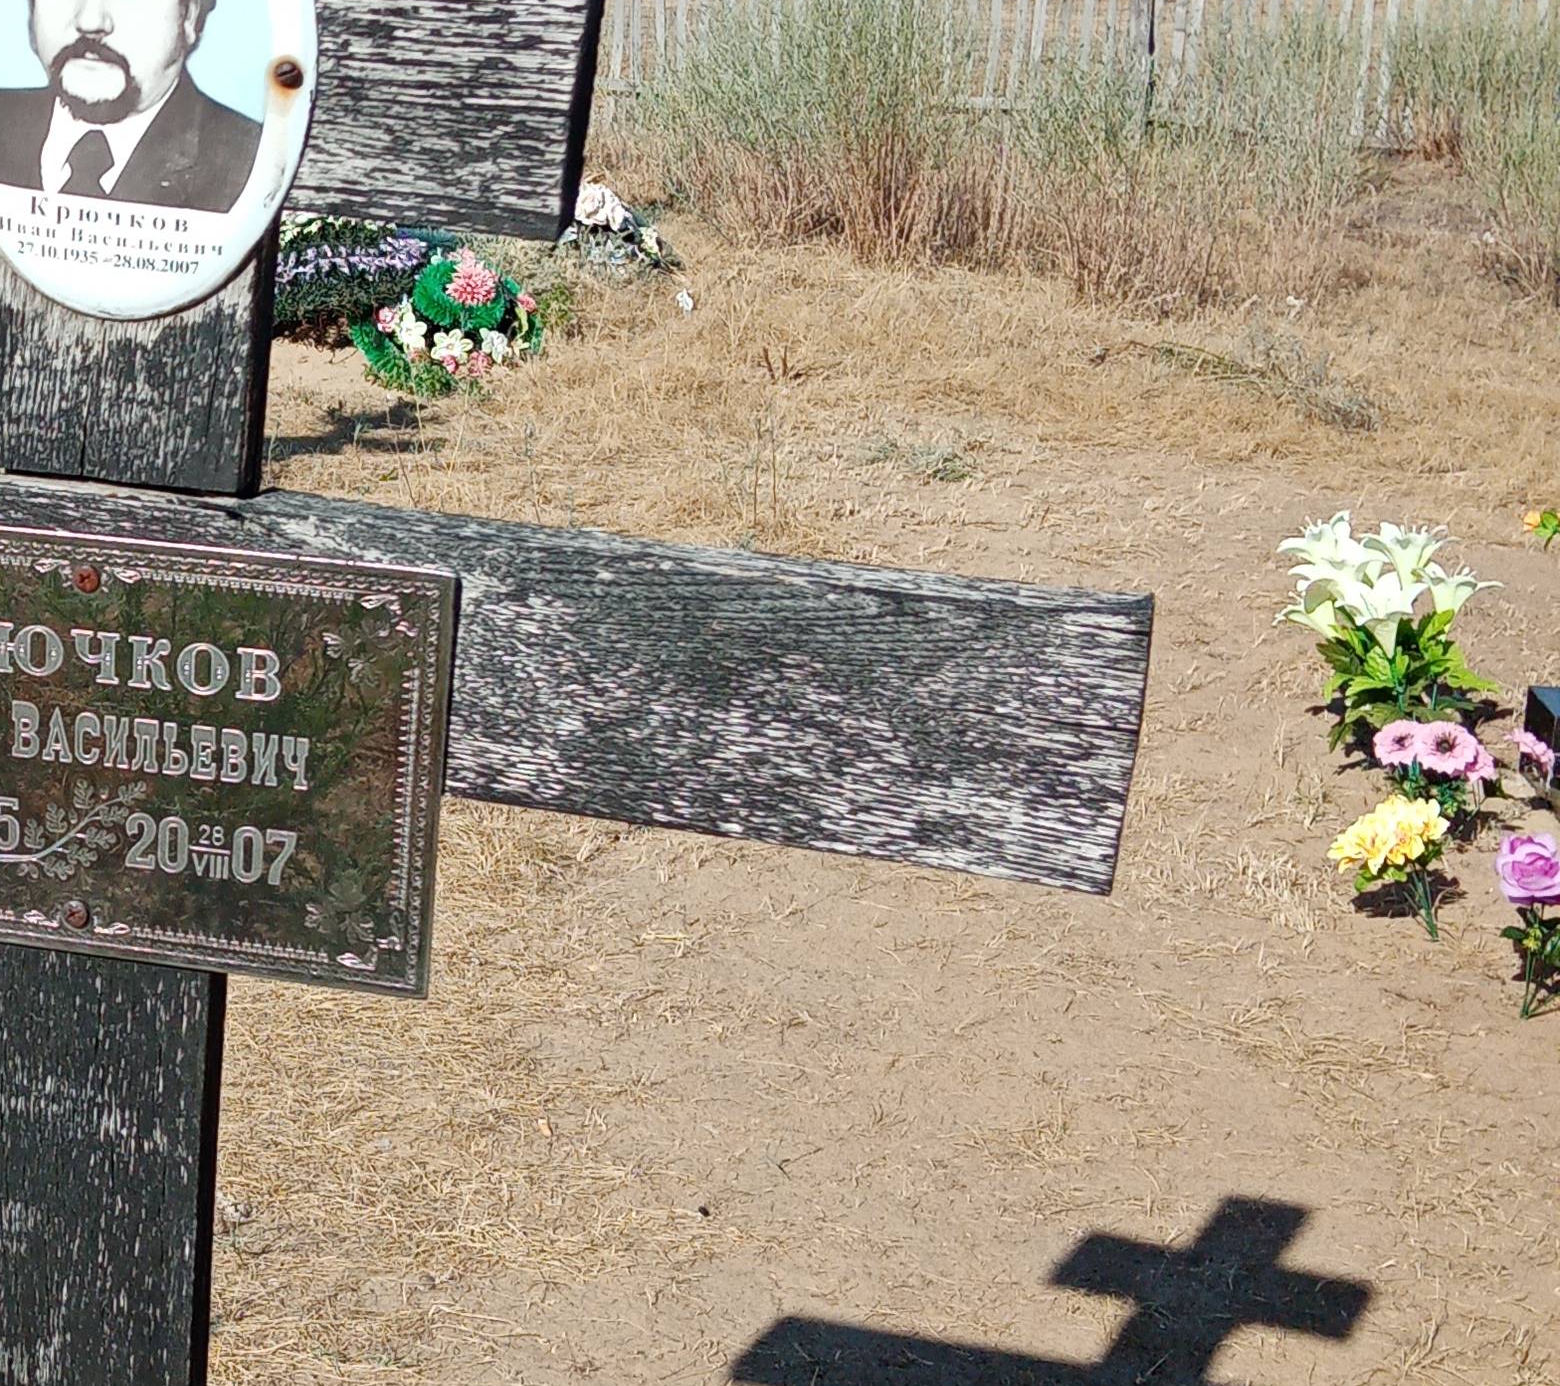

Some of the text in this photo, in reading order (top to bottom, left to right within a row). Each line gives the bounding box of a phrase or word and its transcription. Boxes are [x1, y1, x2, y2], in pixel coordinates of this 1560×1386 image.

[0, 216, 223, 256] Иван Васильевич
[30, 196, 188, 233] Крючков
[11, 699, 310, 791] ВАСИЛЬЕВИЧ
[125, 812, 189, 874] 20
[198, 823, 225, 847] 28
[231, 825, 298, 886] 07
